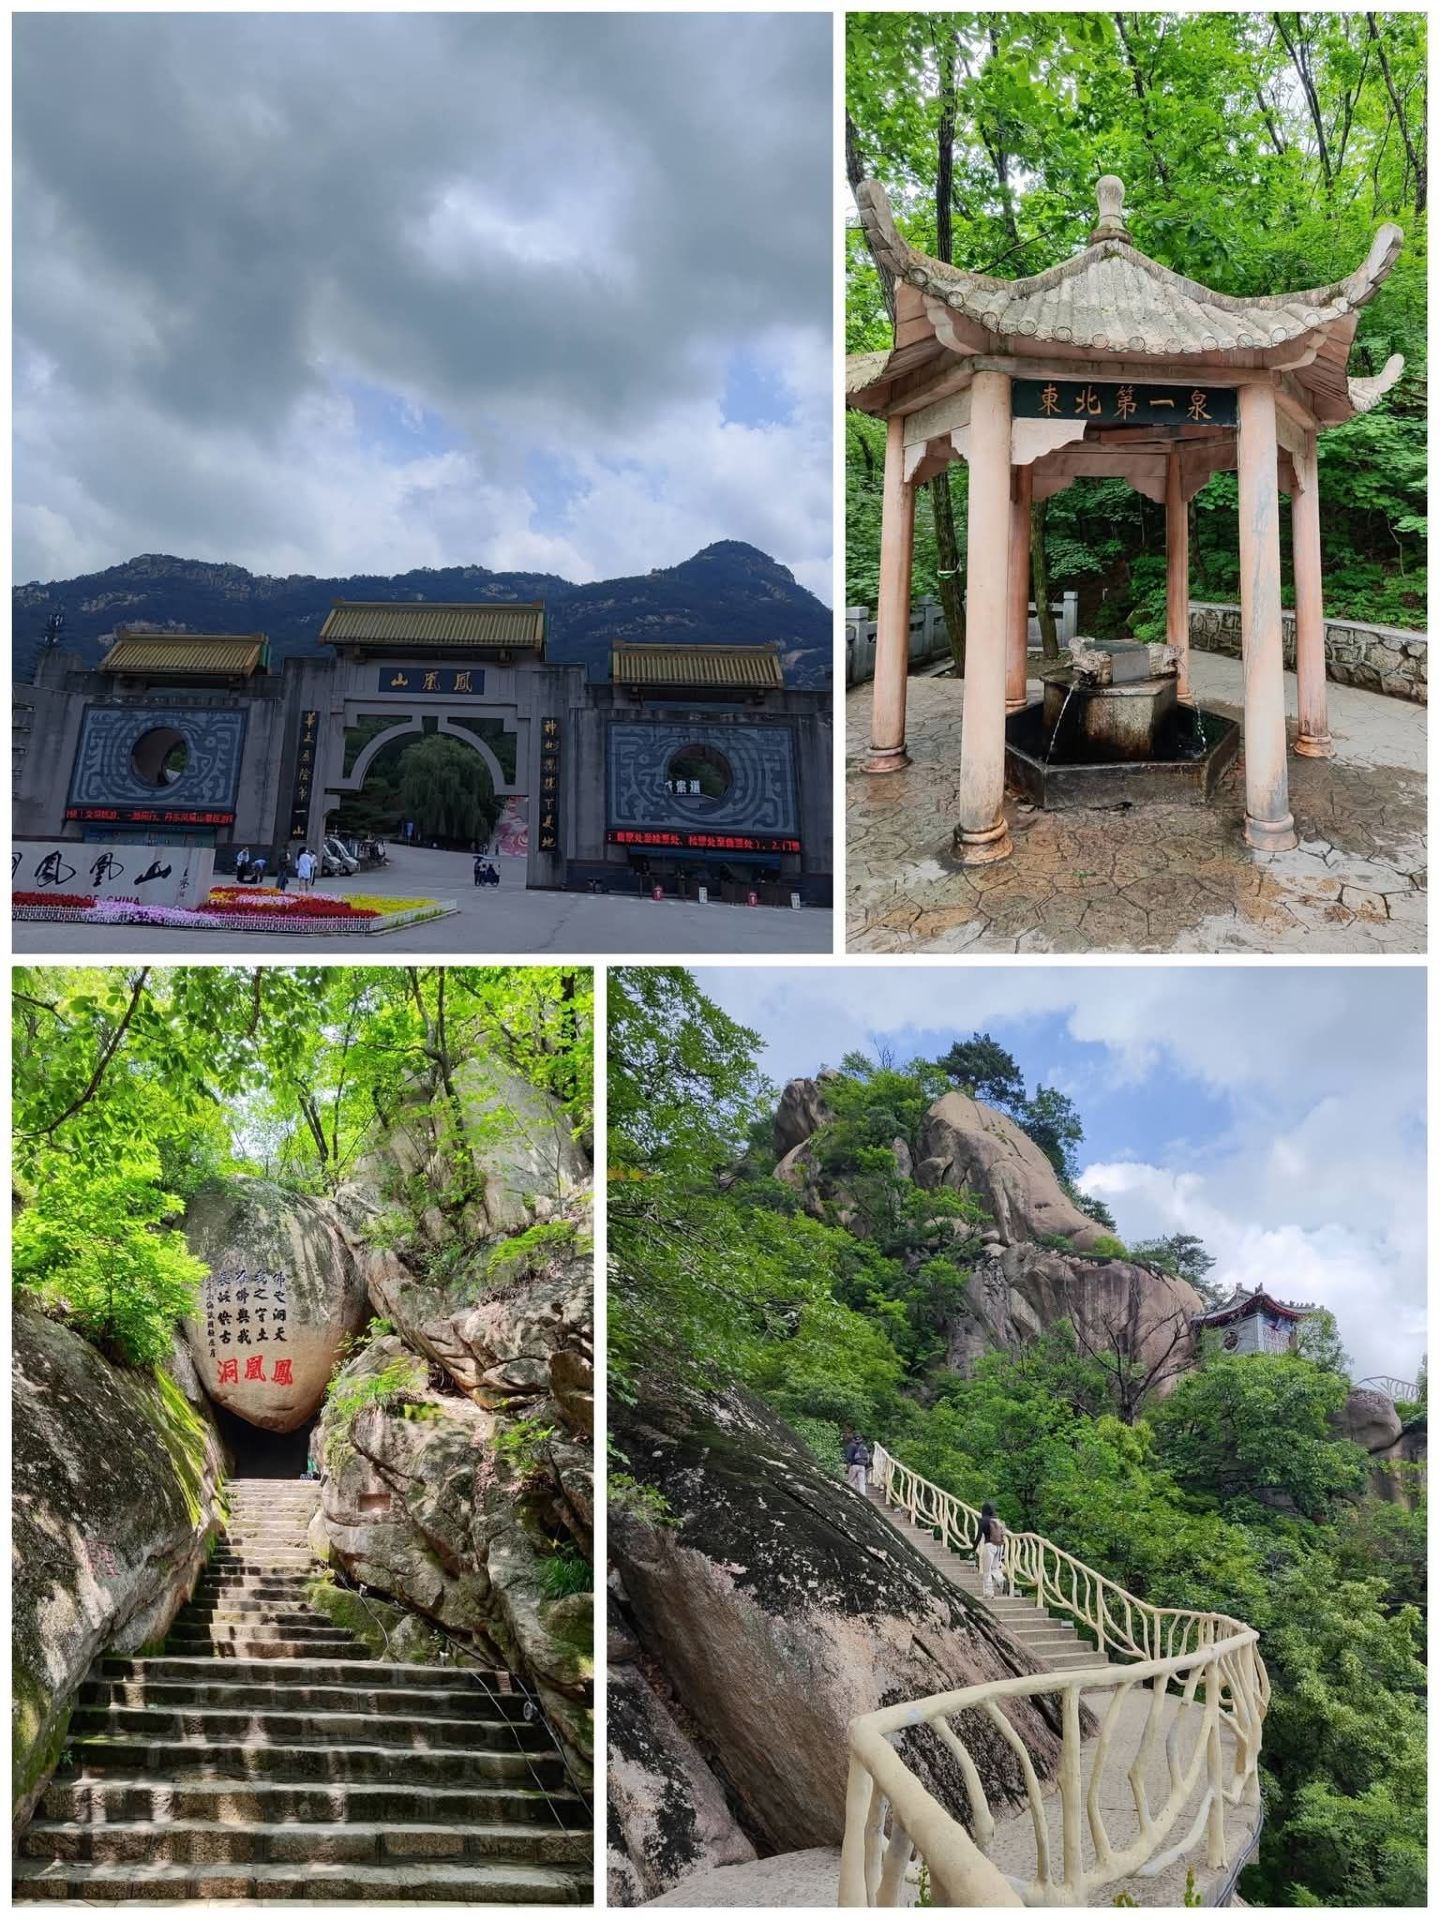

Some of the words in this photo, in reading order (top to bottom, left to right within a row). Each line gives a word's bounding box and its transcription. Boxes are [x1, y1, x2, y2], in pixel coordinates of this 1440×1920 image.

[1037, 383, 1213, 421] 東北第一泉
